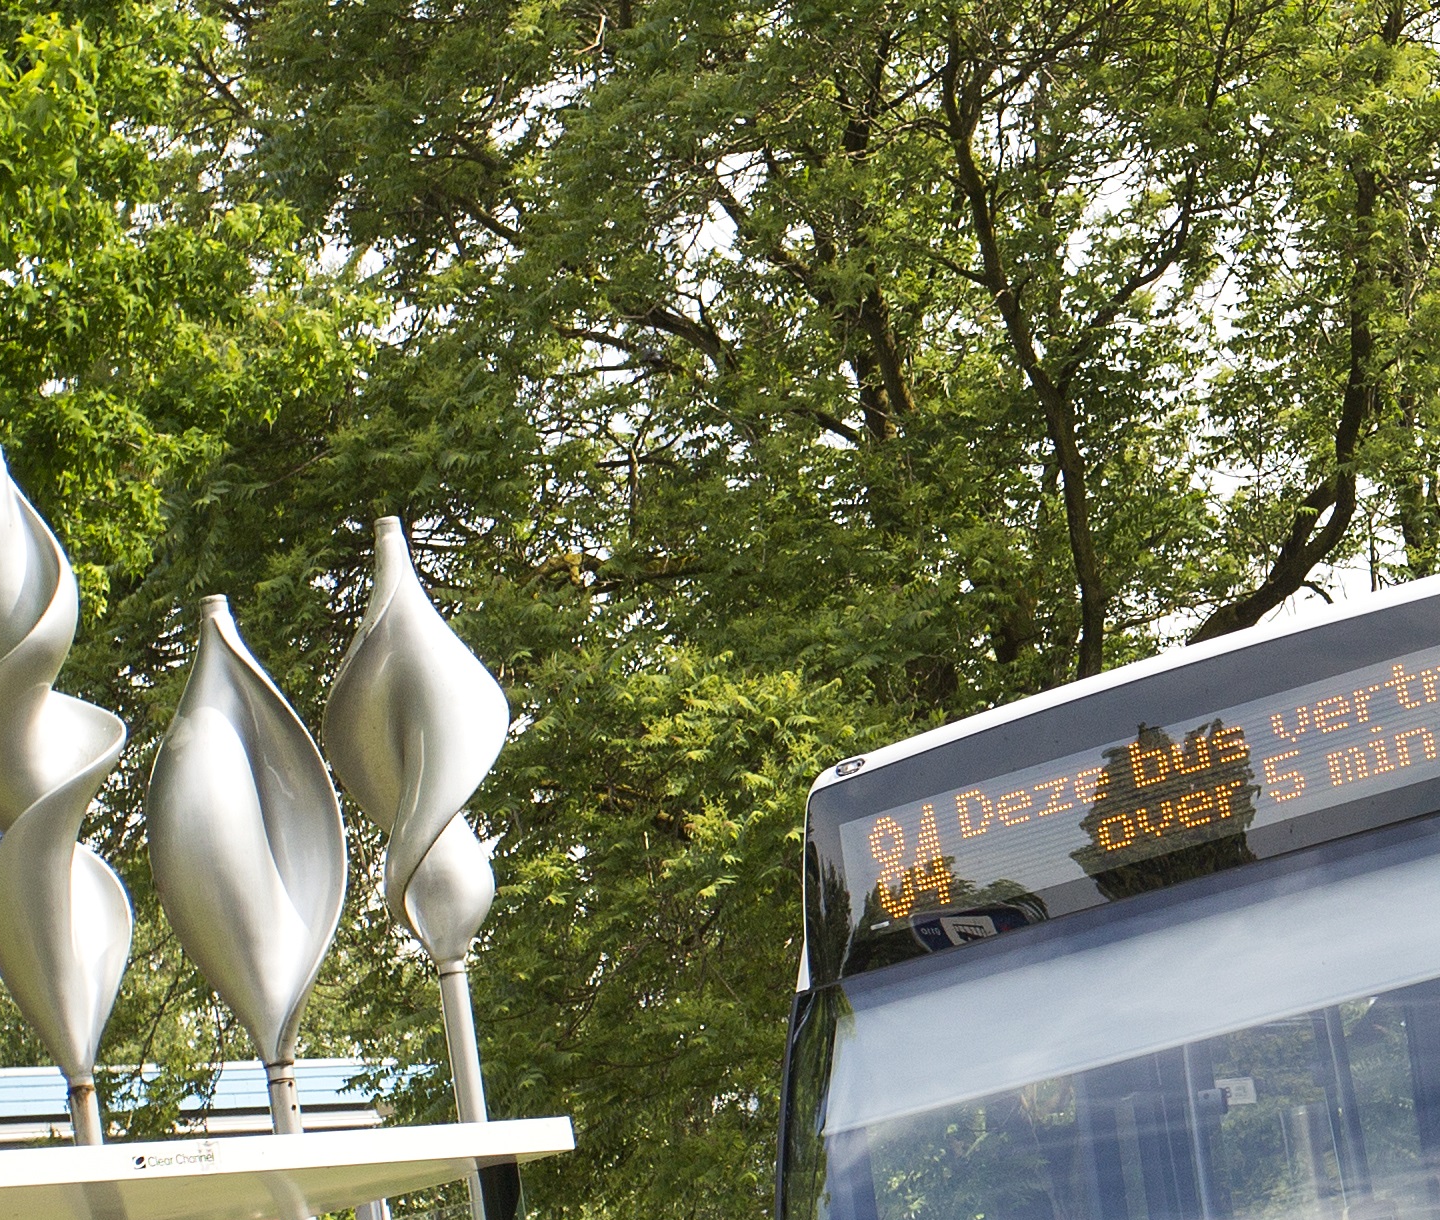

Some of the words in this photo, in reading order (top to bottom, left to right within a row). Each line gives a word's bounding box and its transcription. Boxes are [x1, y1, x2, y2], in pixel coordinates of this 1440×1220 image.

[954, 763, 1109, 839] Deze
[1127, 725, 1250, 788] bus
[1098, 781, 1241, 851] over
[1262, 750, 1306, 803] 5
[1326, 726, 1437, 787] min
[868, 803, 952, 919] 84
[147, 1156, 173, 1167] Clear
[175, 1152, 215, 1165] Channel
